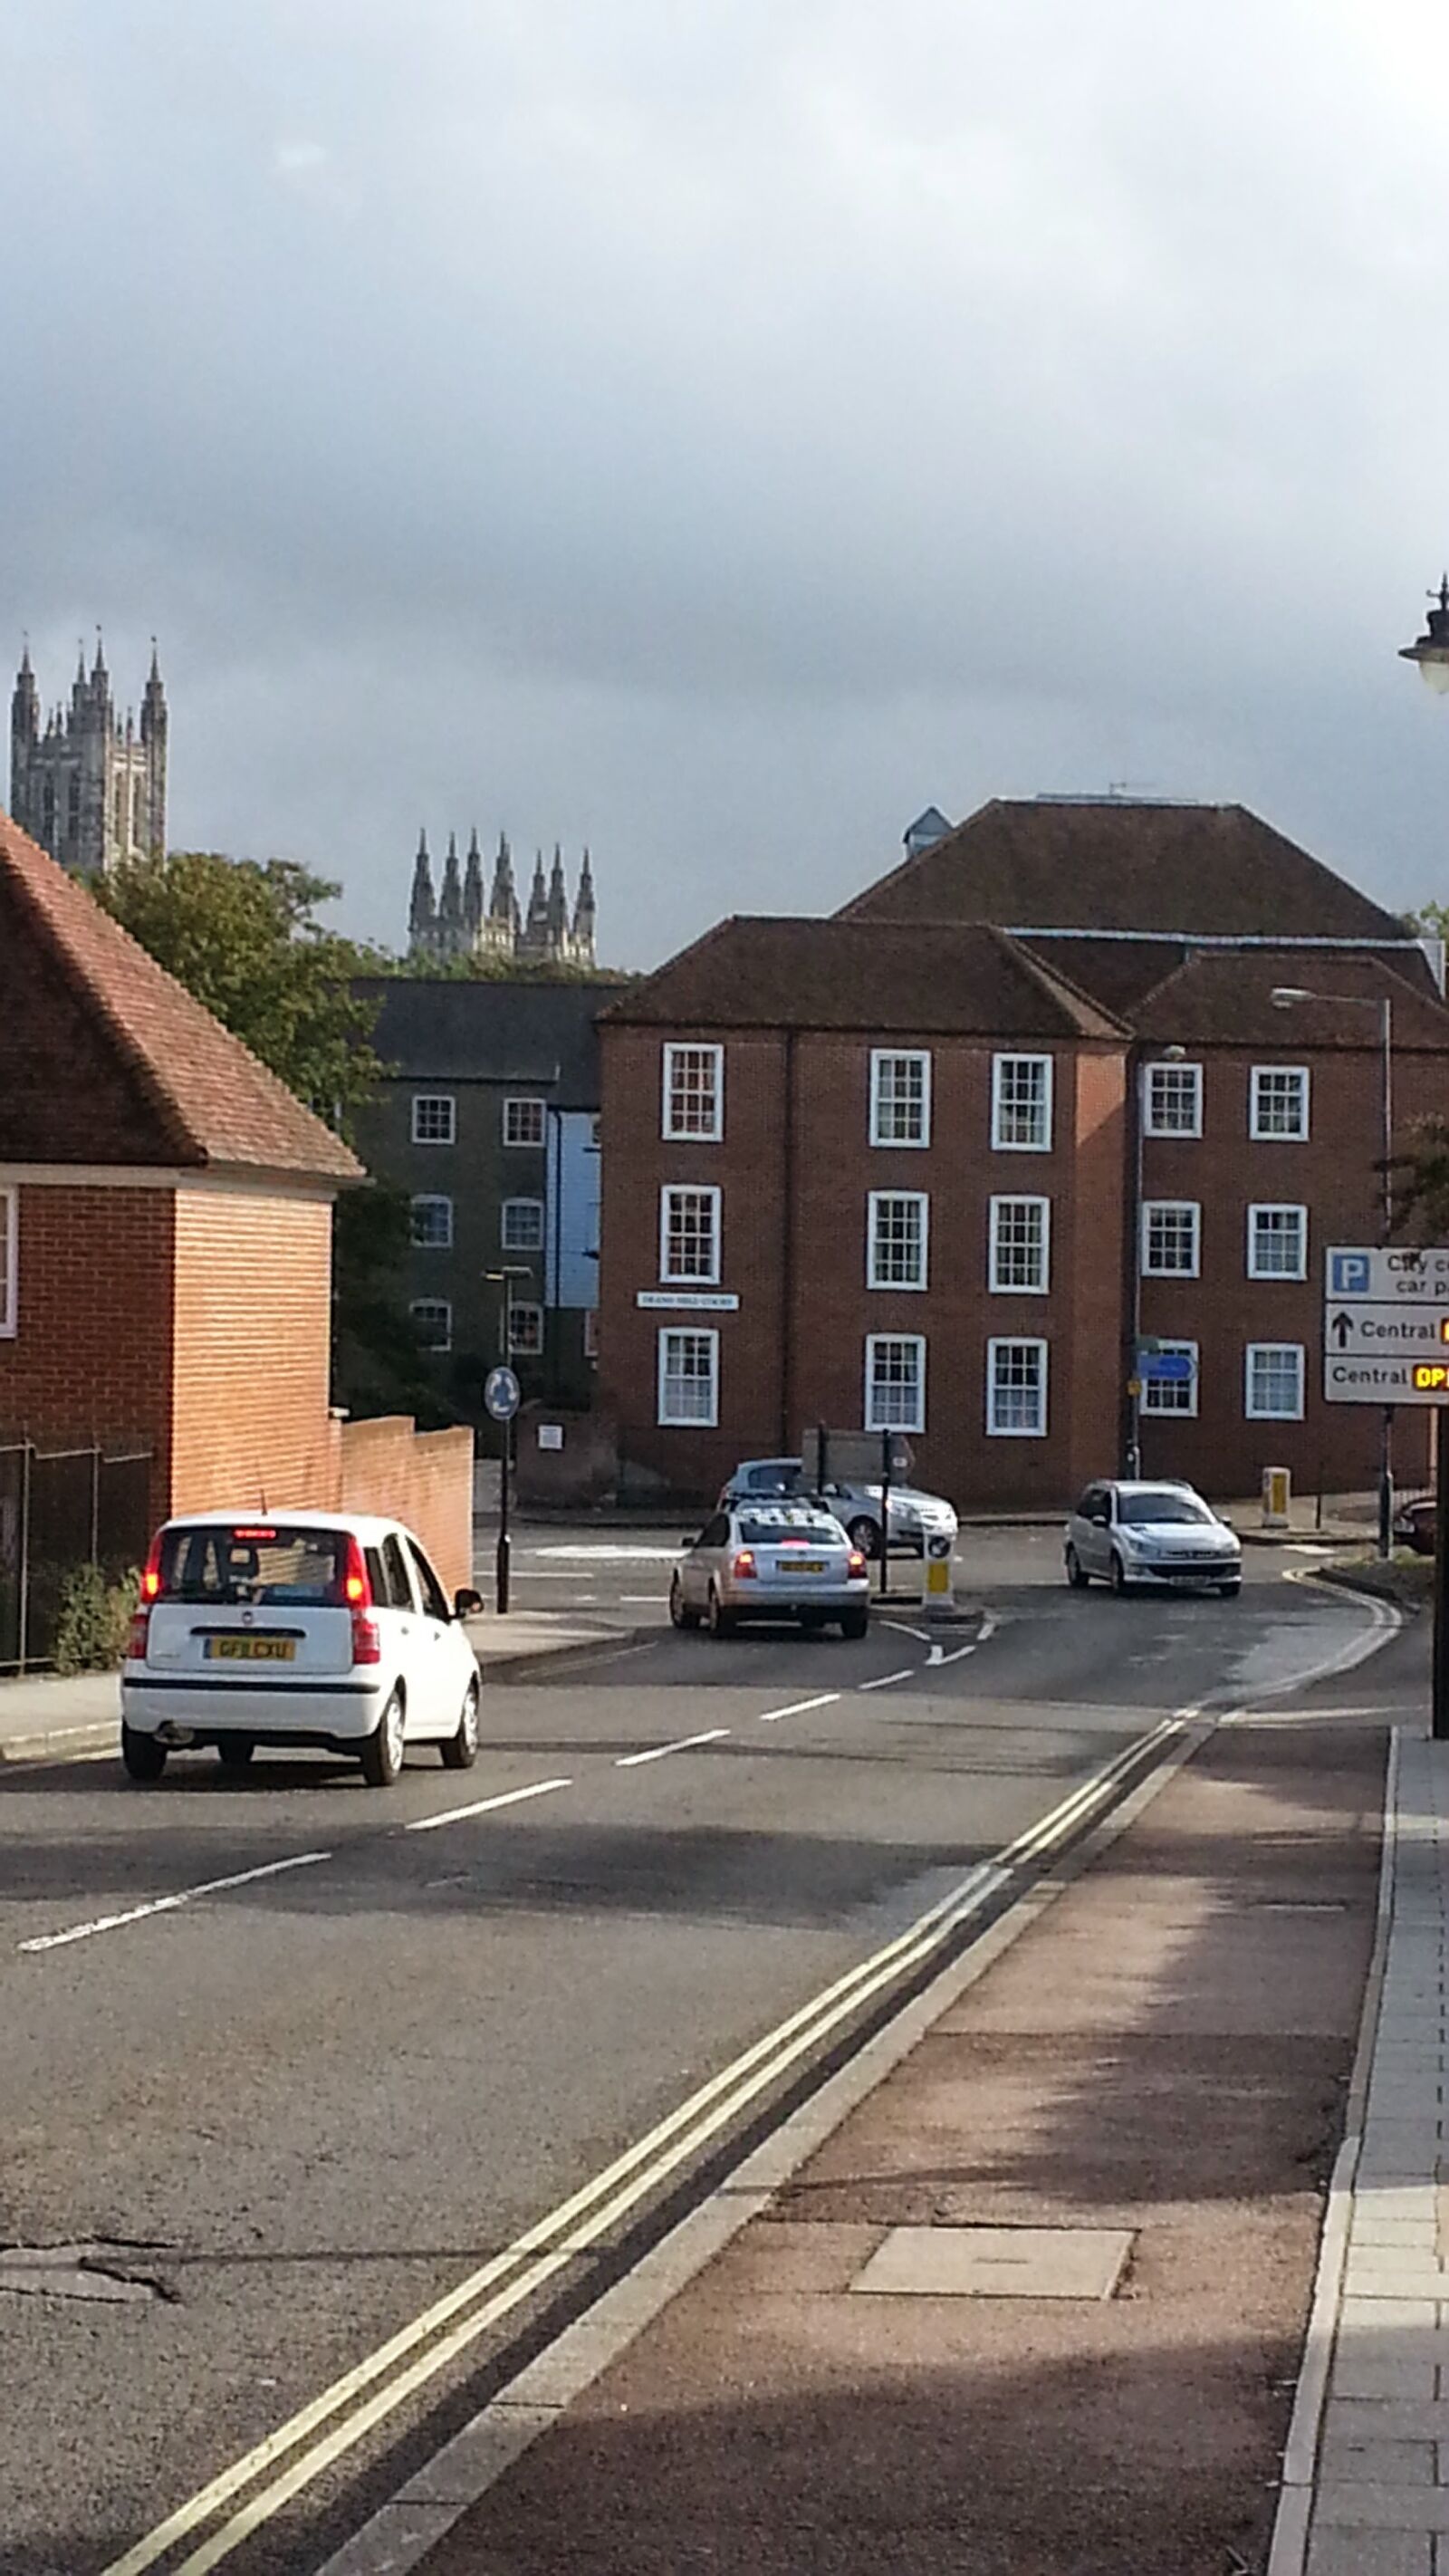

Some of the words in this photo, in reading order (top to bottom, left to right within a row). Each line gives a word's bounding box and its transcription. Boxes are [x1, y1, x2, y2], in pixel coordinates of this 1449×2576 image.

[1341, 1259, 1364, 1290] P
[1396, 1281, 1425, 1293] car
[1360, 1321, 1435, 1339] Central
[1333, 1367, 1408, 1385] Central
[1415, 1367, 1449, 1388] OP
